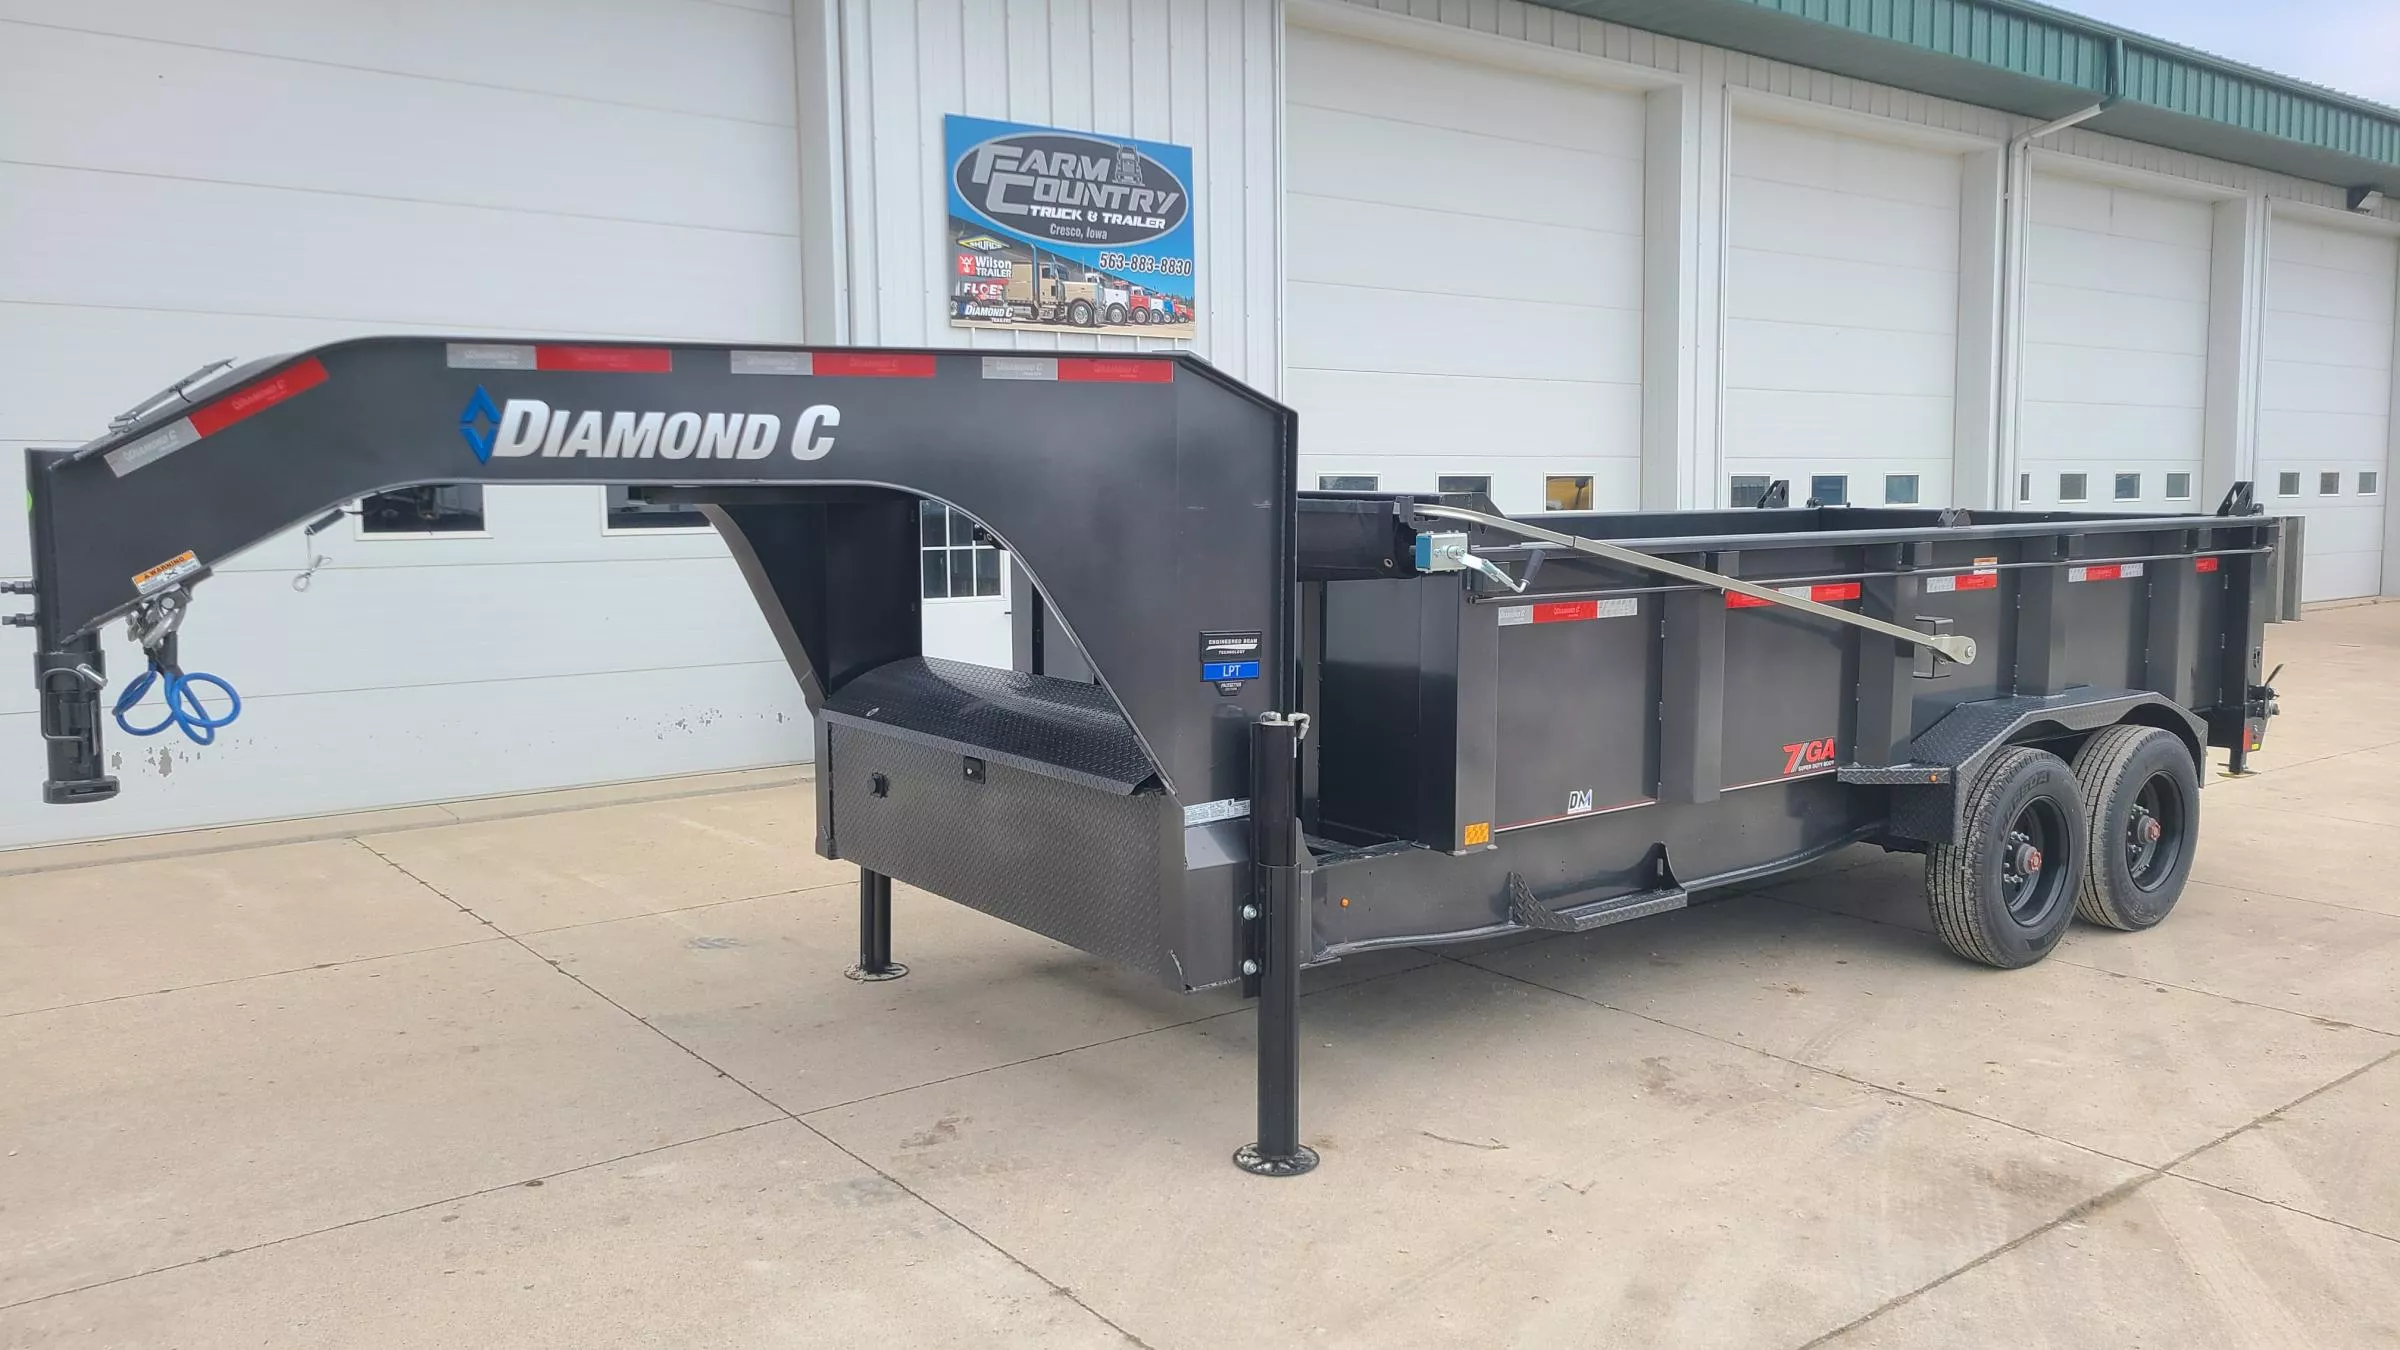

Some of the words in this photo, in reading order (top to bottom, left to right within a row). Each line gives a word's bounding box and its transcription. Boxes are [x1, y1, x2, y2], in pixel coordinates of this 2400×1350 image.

[972, 144, 1111, 184] FARM
[986, 171, 1180, 215] COUNTRY
[1030, 205, 1083, 221] TRUCK
[1087, 211, 1098, 223] &
[1102, 212, 1166, 229] TRAILER
[1050, 223, 1083, 239] Cresco,
[1086, 225, 1108, 240] Iowa
[975, 255, 1012, 270] Wilson
[1099, 251, 1193, 276] 563-883-8830
[976, 268, 1012, 278] TRAILER
[965, 304, 1005, 317] DIAMOND
[1005, 307, 1014, 317] C
[492, 399, 781, 460] DIAMOND
[791, 404, 841, 461] C
[150, 556, 185, 576] WARNING
[1223, 665, 1241, 677] LPT
[1570, 790, 1592, 809] DM
